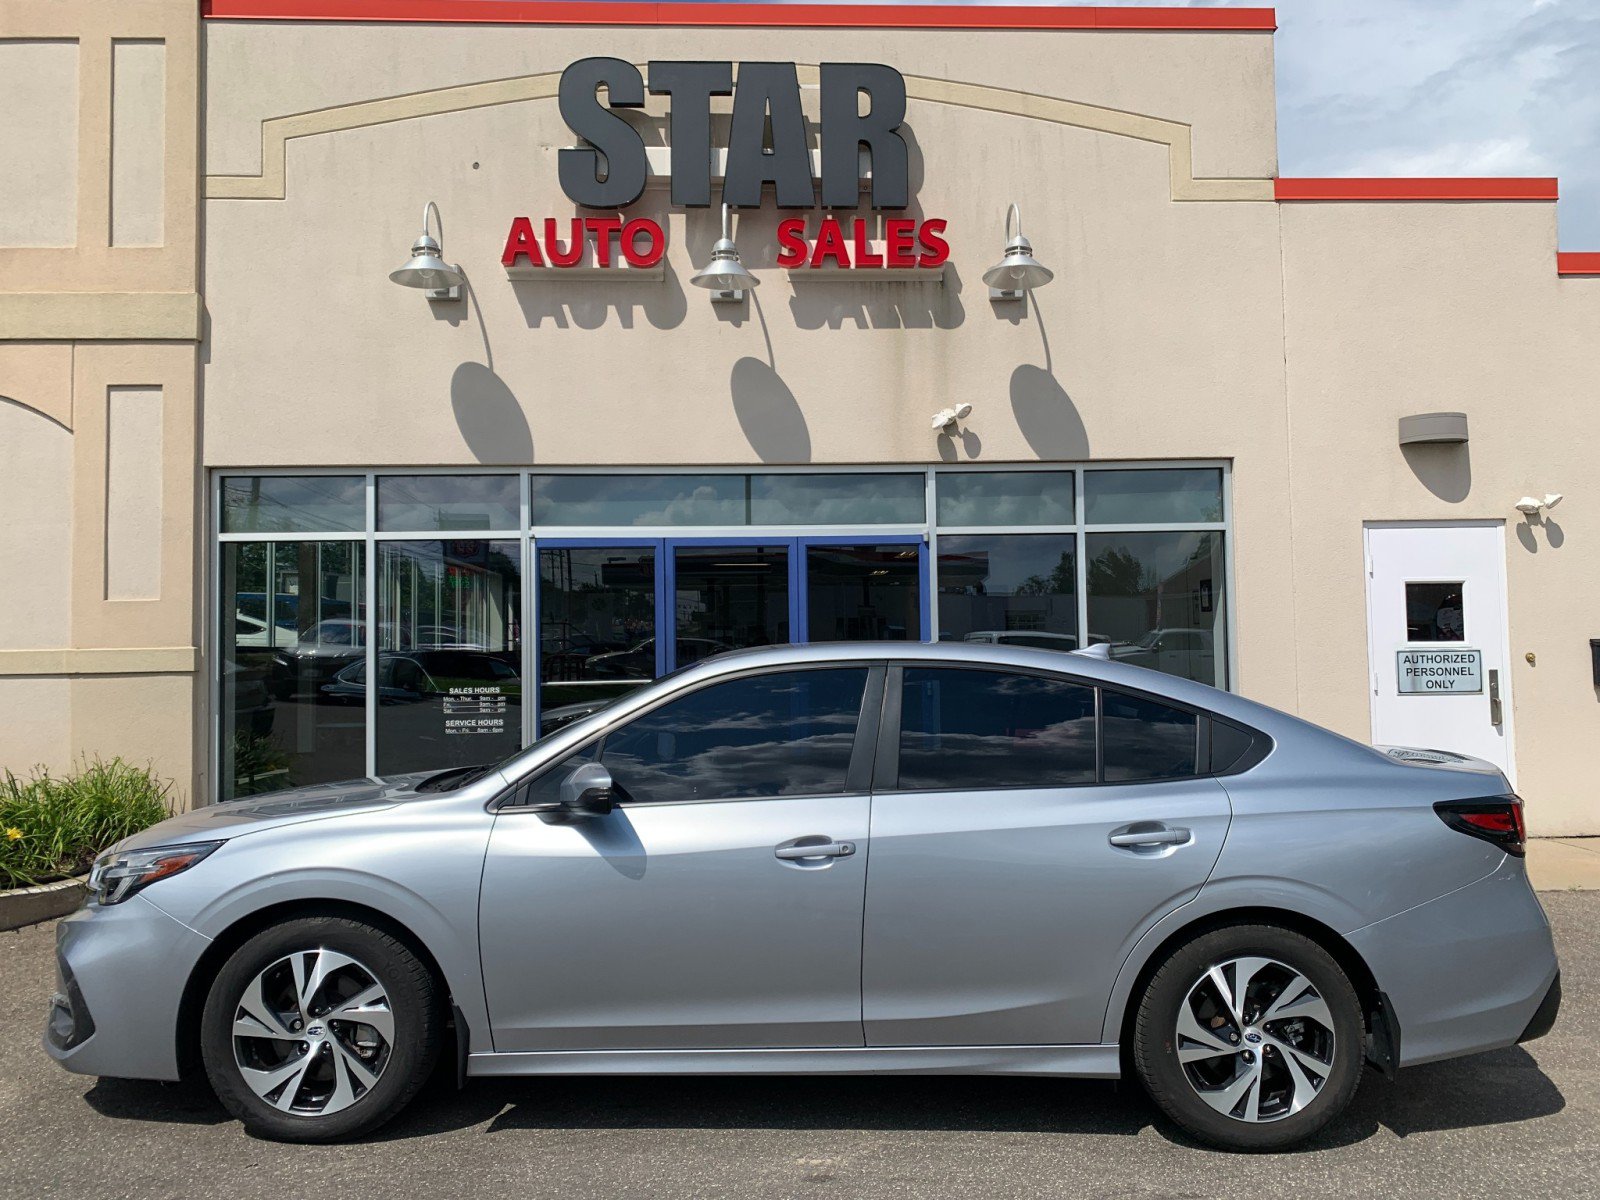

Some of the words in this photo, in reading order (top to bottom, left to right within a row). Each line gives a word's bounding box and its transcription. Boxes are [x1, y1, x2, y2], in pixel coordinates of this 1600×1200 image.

[558, 56, 909, 210] STAR
[501, 216, 665, 268] AUTO
[776, 218, 950, 269] SALES
[1403, 654, 1476, 664] AUTHORIZED
[1406, 666, 1474, 677] PERSONNEL
[1425, 679, 1455, 689] ONLY
